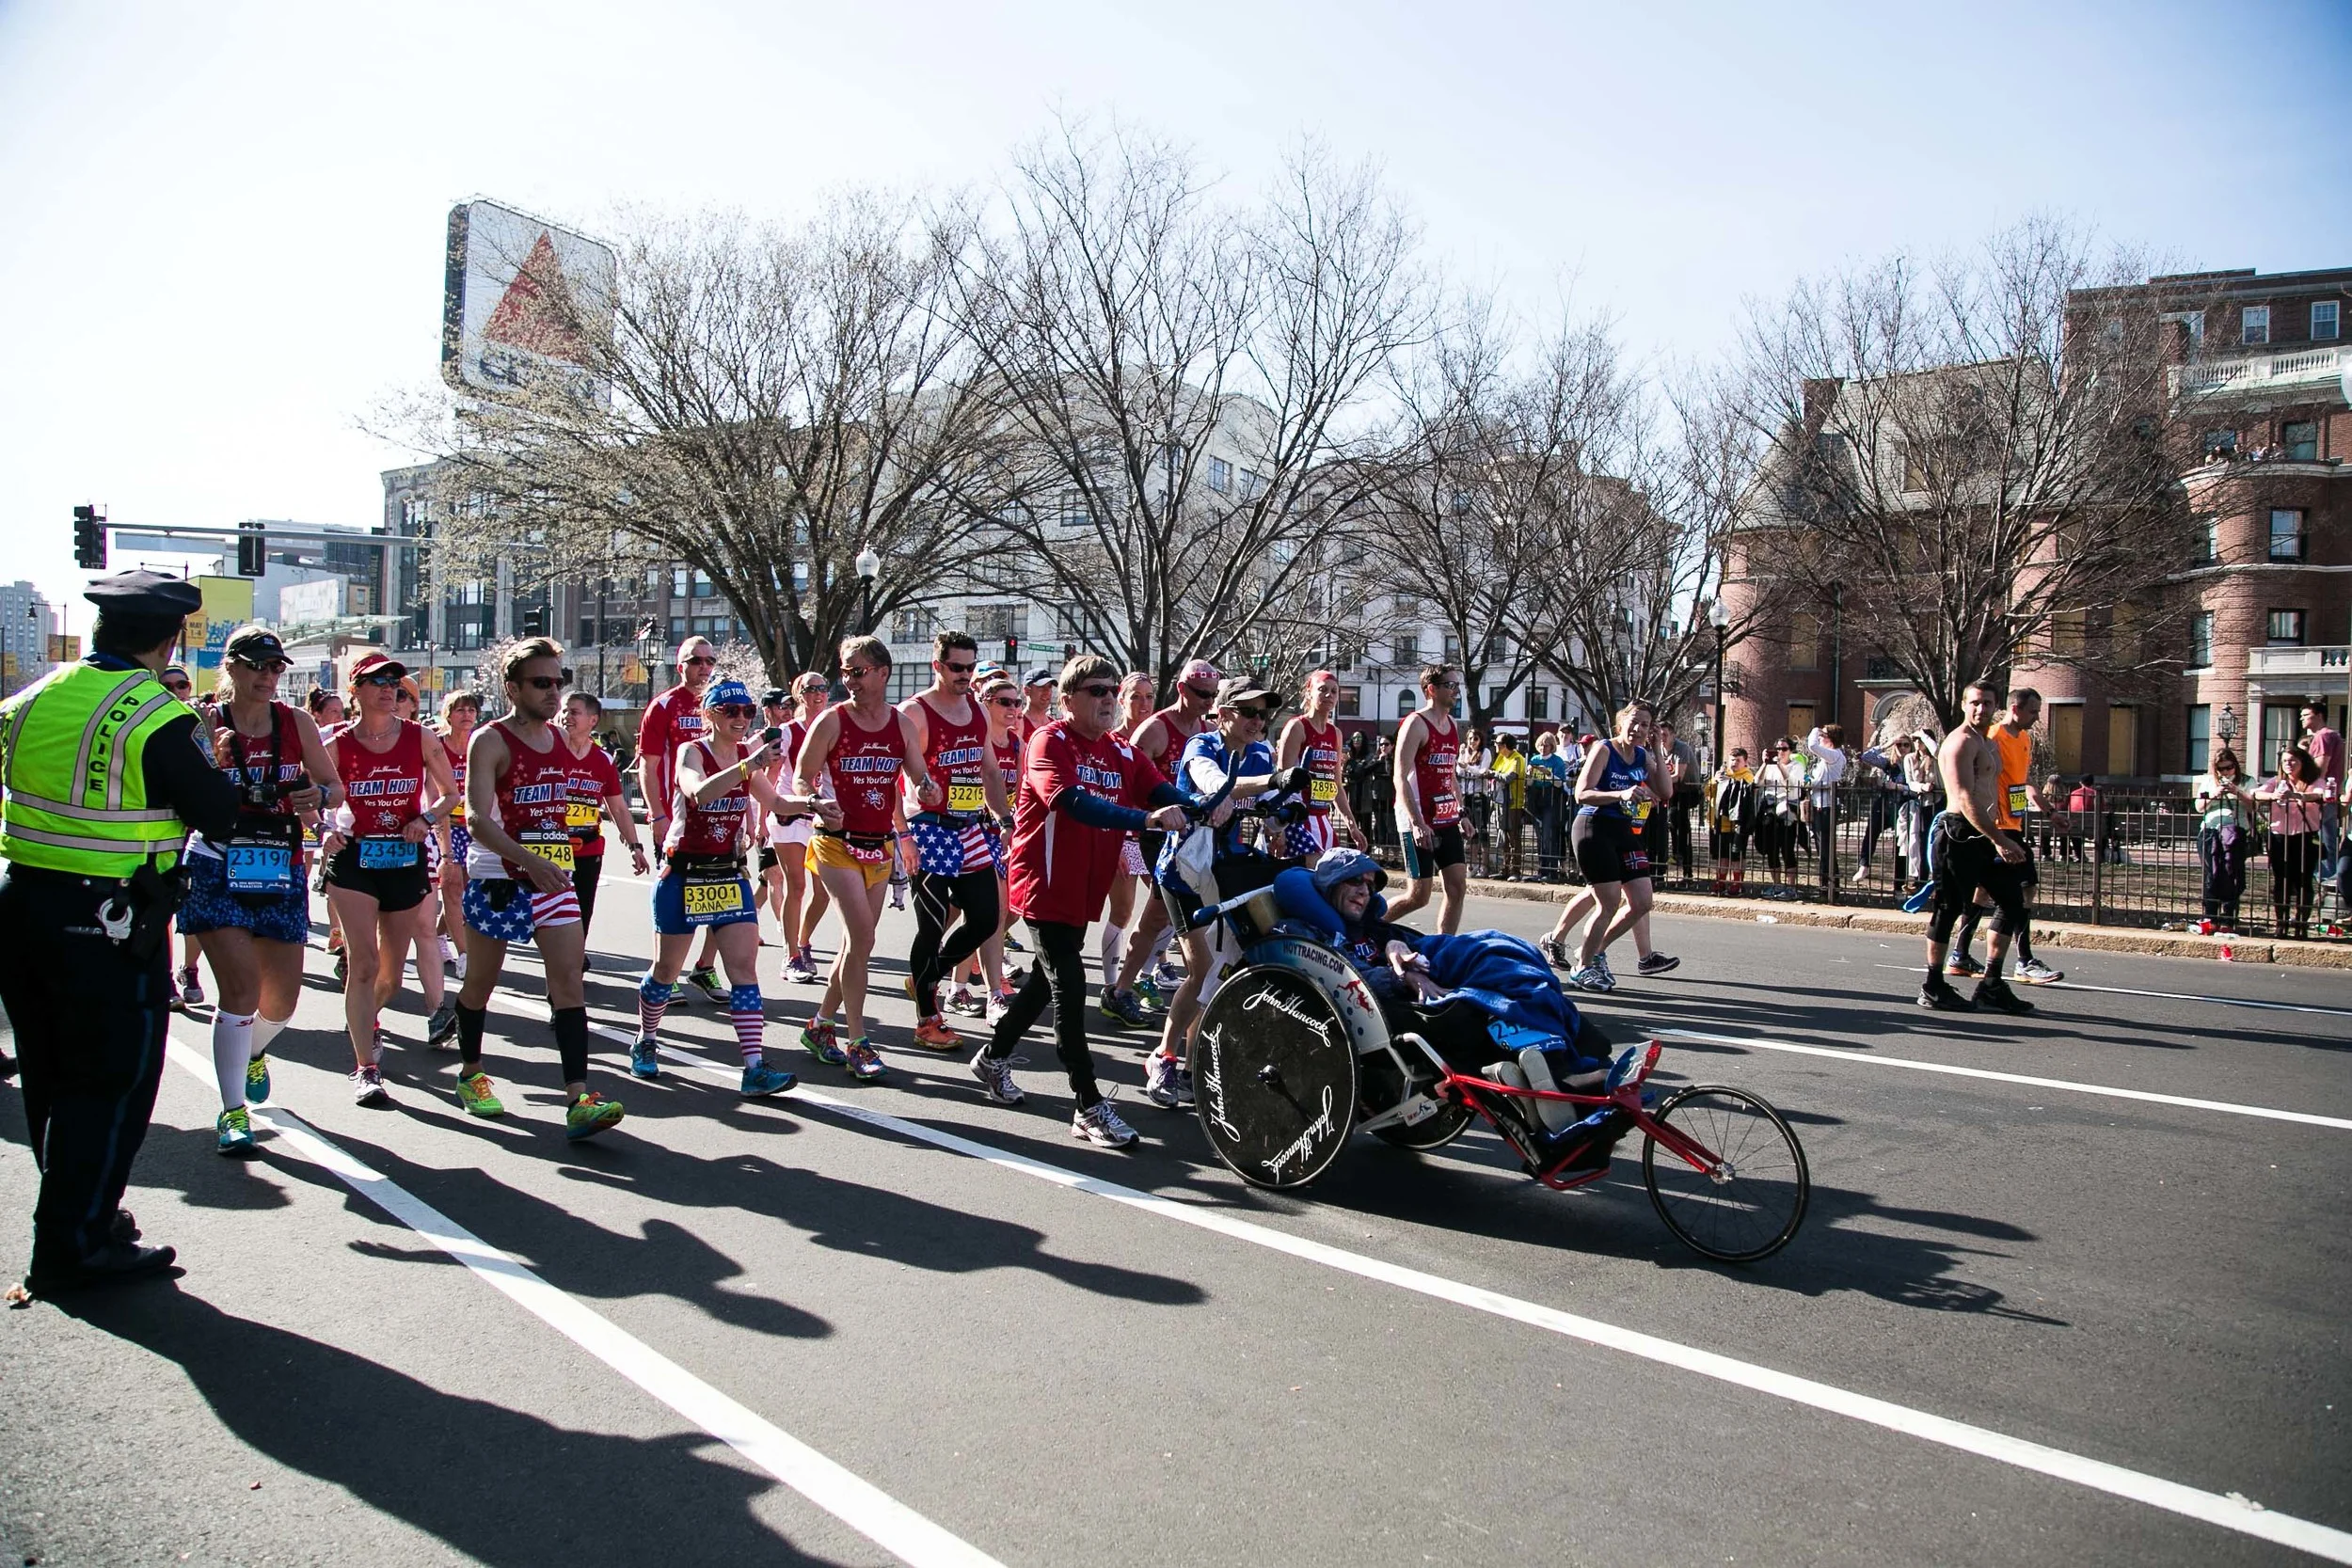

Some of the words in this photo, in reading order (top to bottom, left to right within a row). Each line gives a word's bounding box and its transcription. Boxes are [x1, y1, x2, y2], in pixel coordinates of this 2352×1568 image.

[721, 689, 731, 699] YES
[89, 696, 140, 792] POLICE
[938, 749, 967, 768] TEAM
[1312, 749, 1328, 761] EAM
[840, 756, 875, 772] TEAM
[853, 775, 865, 784] Yes
[866, 775, 880, 784] You
[1611, 771, 1629, 781] Team
[350, 779, 386, 798] TEAM
[387, 778, 419, 795] HOYT
[580, 780, 603, 793] HOYT
[514, 784, 552, 804] TEAM
[573, 796, 598, 805] adidas
[363, 799, 376, 807] Yes
[377, 799, 392, 807] You
[393, 798, 409, 807] Can!
[530, 807, 544, 816] Yes
[542, 831, 569, 841] adidas
[230, 848, 290, 868] 23190
[524, 846, 572, 863] 2548
[361, 858, 368, 867] 6
[229, 867, 237, 879] 6
[686, 885, 737, 903] 33001
[686, 905, 691, 913] 7
[695, 900, 724, 913] DANA
[1282, 942, 1346, 976] HOYTRACING.COM
[1243, 980, 1282, 1010] John
[1210, 1096, 1241, 1143] John
[1309, 1085, 1336, 1143] John
